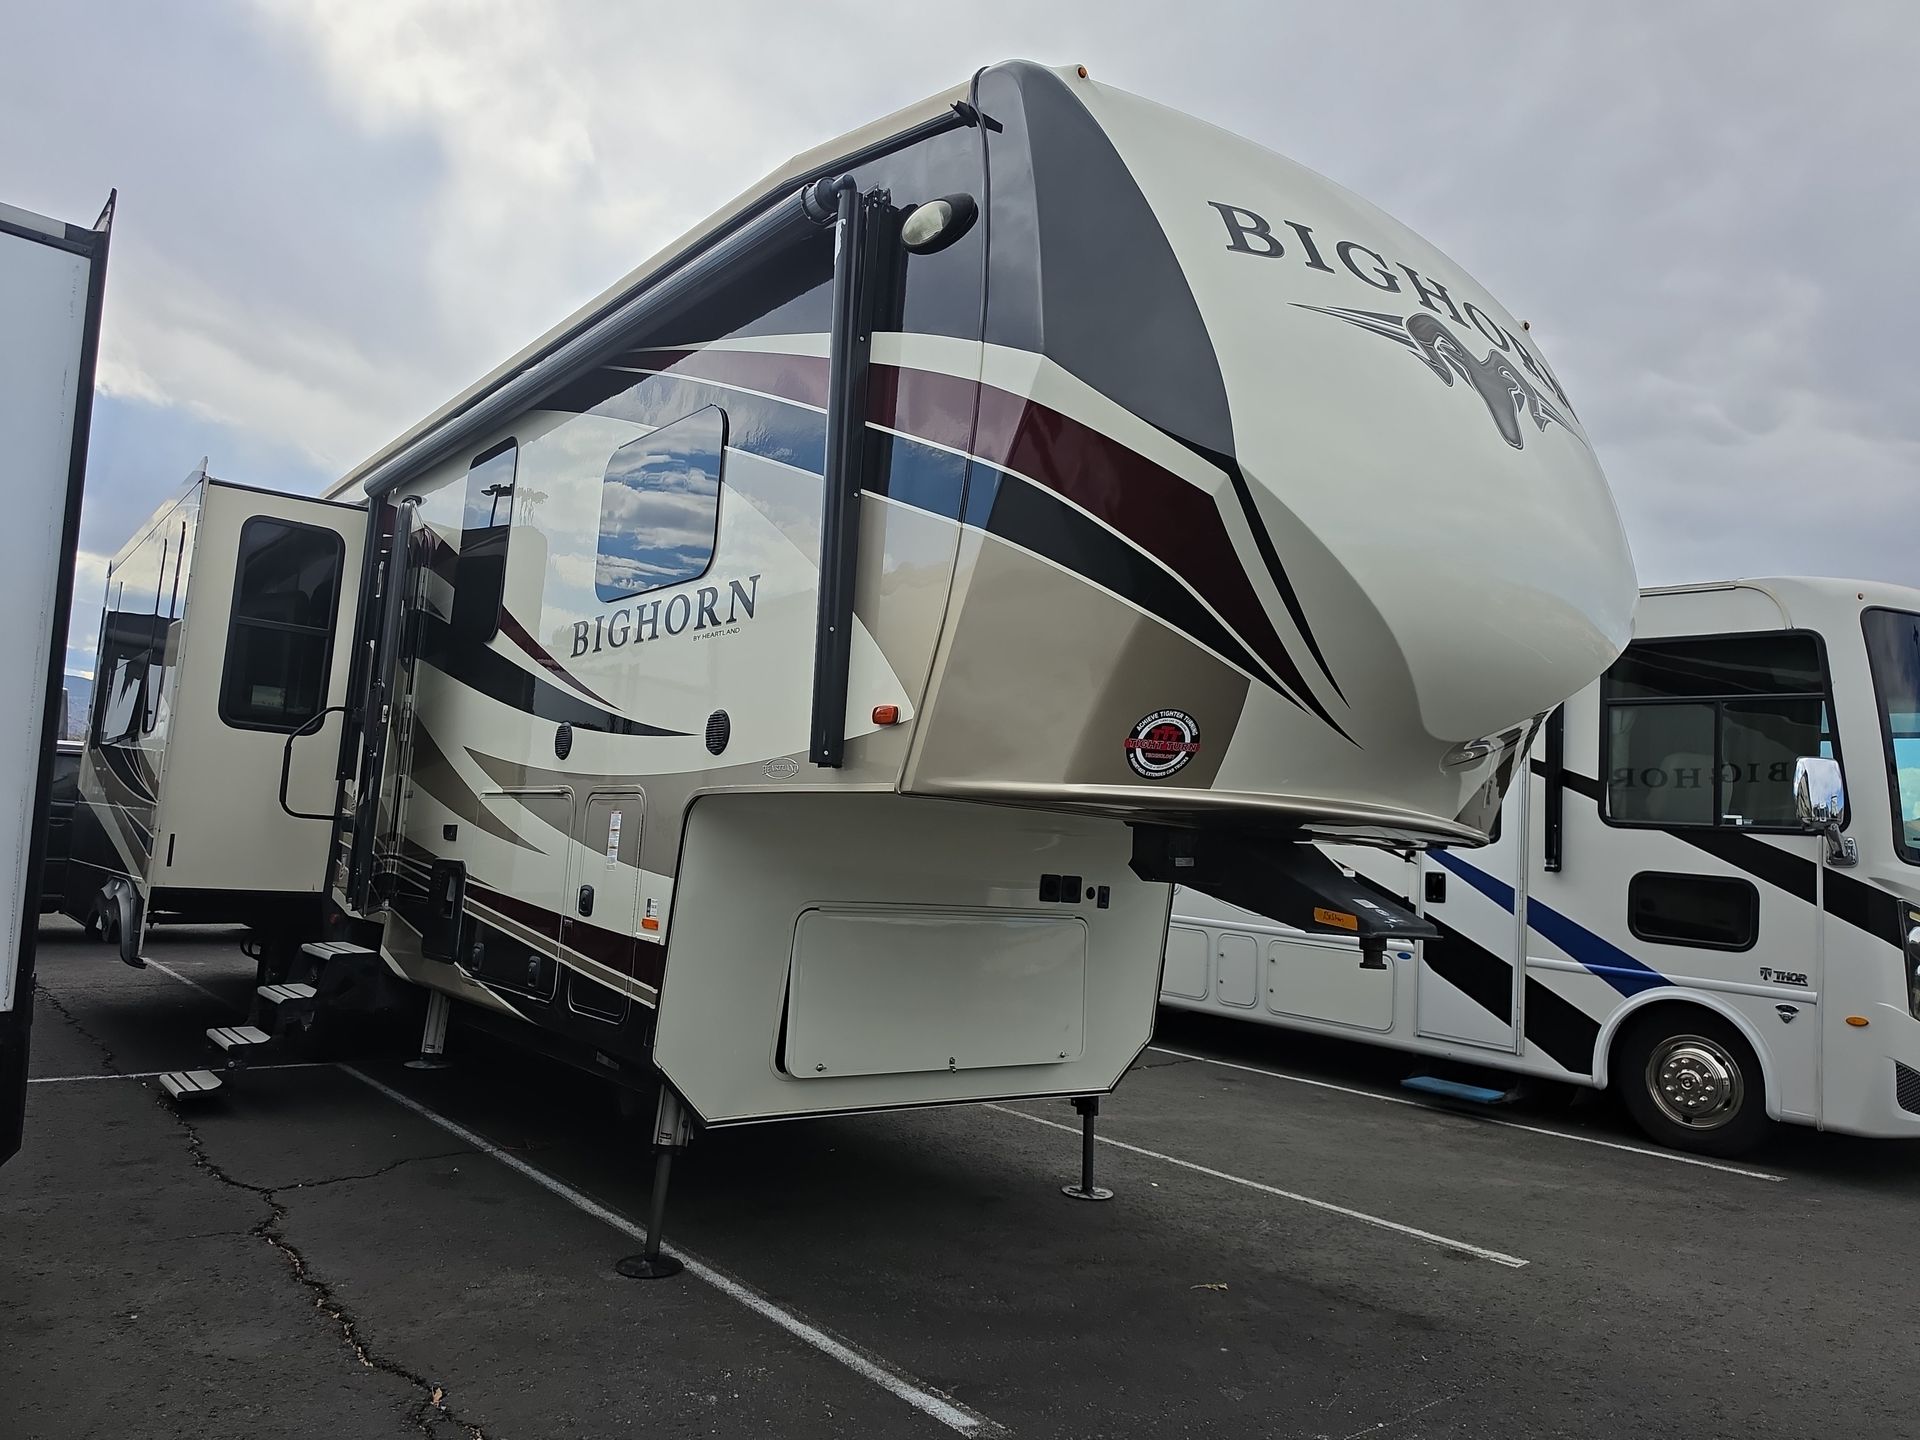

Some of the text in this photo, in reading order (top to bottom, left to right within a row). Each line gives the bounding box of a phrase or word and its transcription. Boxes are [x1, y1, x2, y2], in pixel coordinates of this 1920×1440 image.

[1207, 200, 1580, 425] BIGHORN
[571, 575, 760, 658] BIGHORN
[693, 627, 741, 642] BY HEARTLAND
[1136, 712, 1159, 731] ACHIEVE
[1129, 738, 1198, 752] TIGHT TURN
[1773, 970, 1808, 984] THOR
